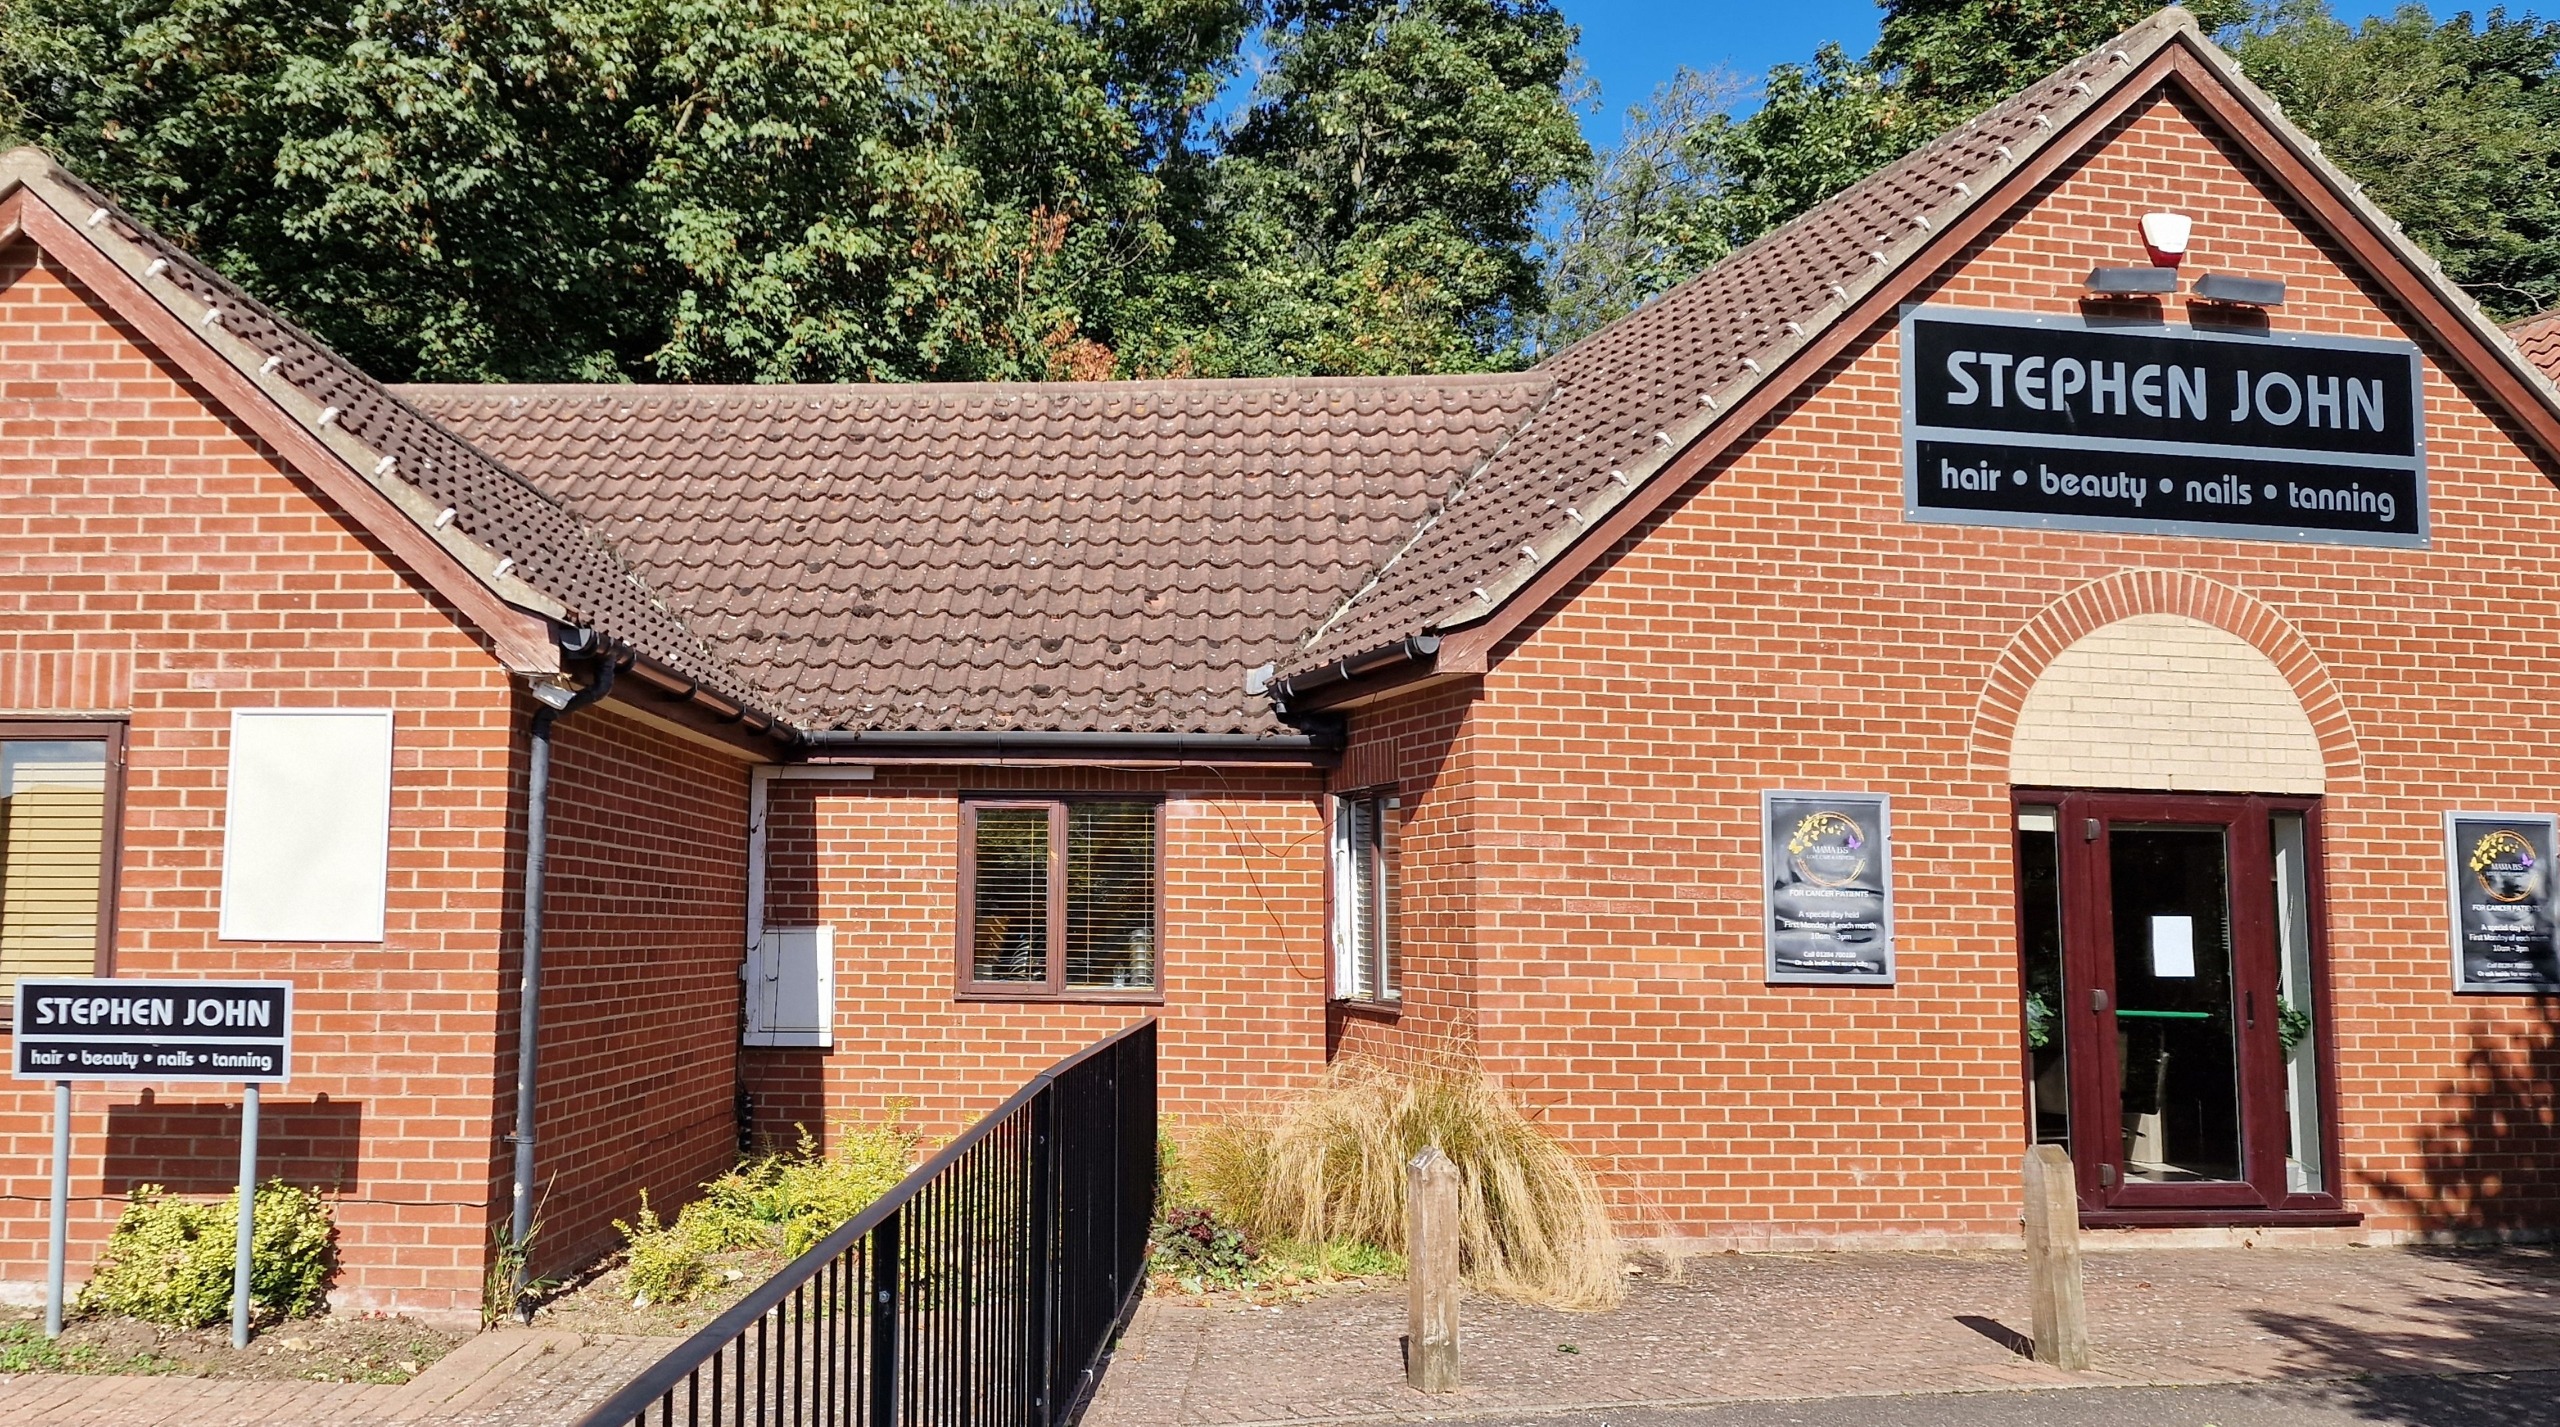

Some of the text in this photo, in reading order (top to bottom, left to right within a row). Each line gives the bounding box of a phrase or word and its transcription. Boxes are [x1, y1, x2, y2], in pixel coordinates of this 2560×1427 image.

[1946, 350, 2385, 432] STEPHEN JOHN
[1940, 458, 2396, 522] hair beauty nails tanning
[1789, 889, 1869, 898] FOR CANCER PATIENTS
[1805, 911, 1830, 919] special
[1831, 911, 1844, 919] day
[1844, 911, 1860, 919] held
[1784, 920, 1800, 928] First
[1800, 921, 1828, 929] Monday
[1855, 922, 1877, 930] month
[2509, 924, 2521, 932] day
[1811, 932, 1830, 940] 10am
[1836, 932, 1852, 941] 3pm
[2469, 933, 2483, 941] First
[2484, 934, 2508, 942] Monday
[36, 997, 270, 1027] STEPHEN JOHN
[30, 1050, 272, 1071] hair beauty nails tanning
